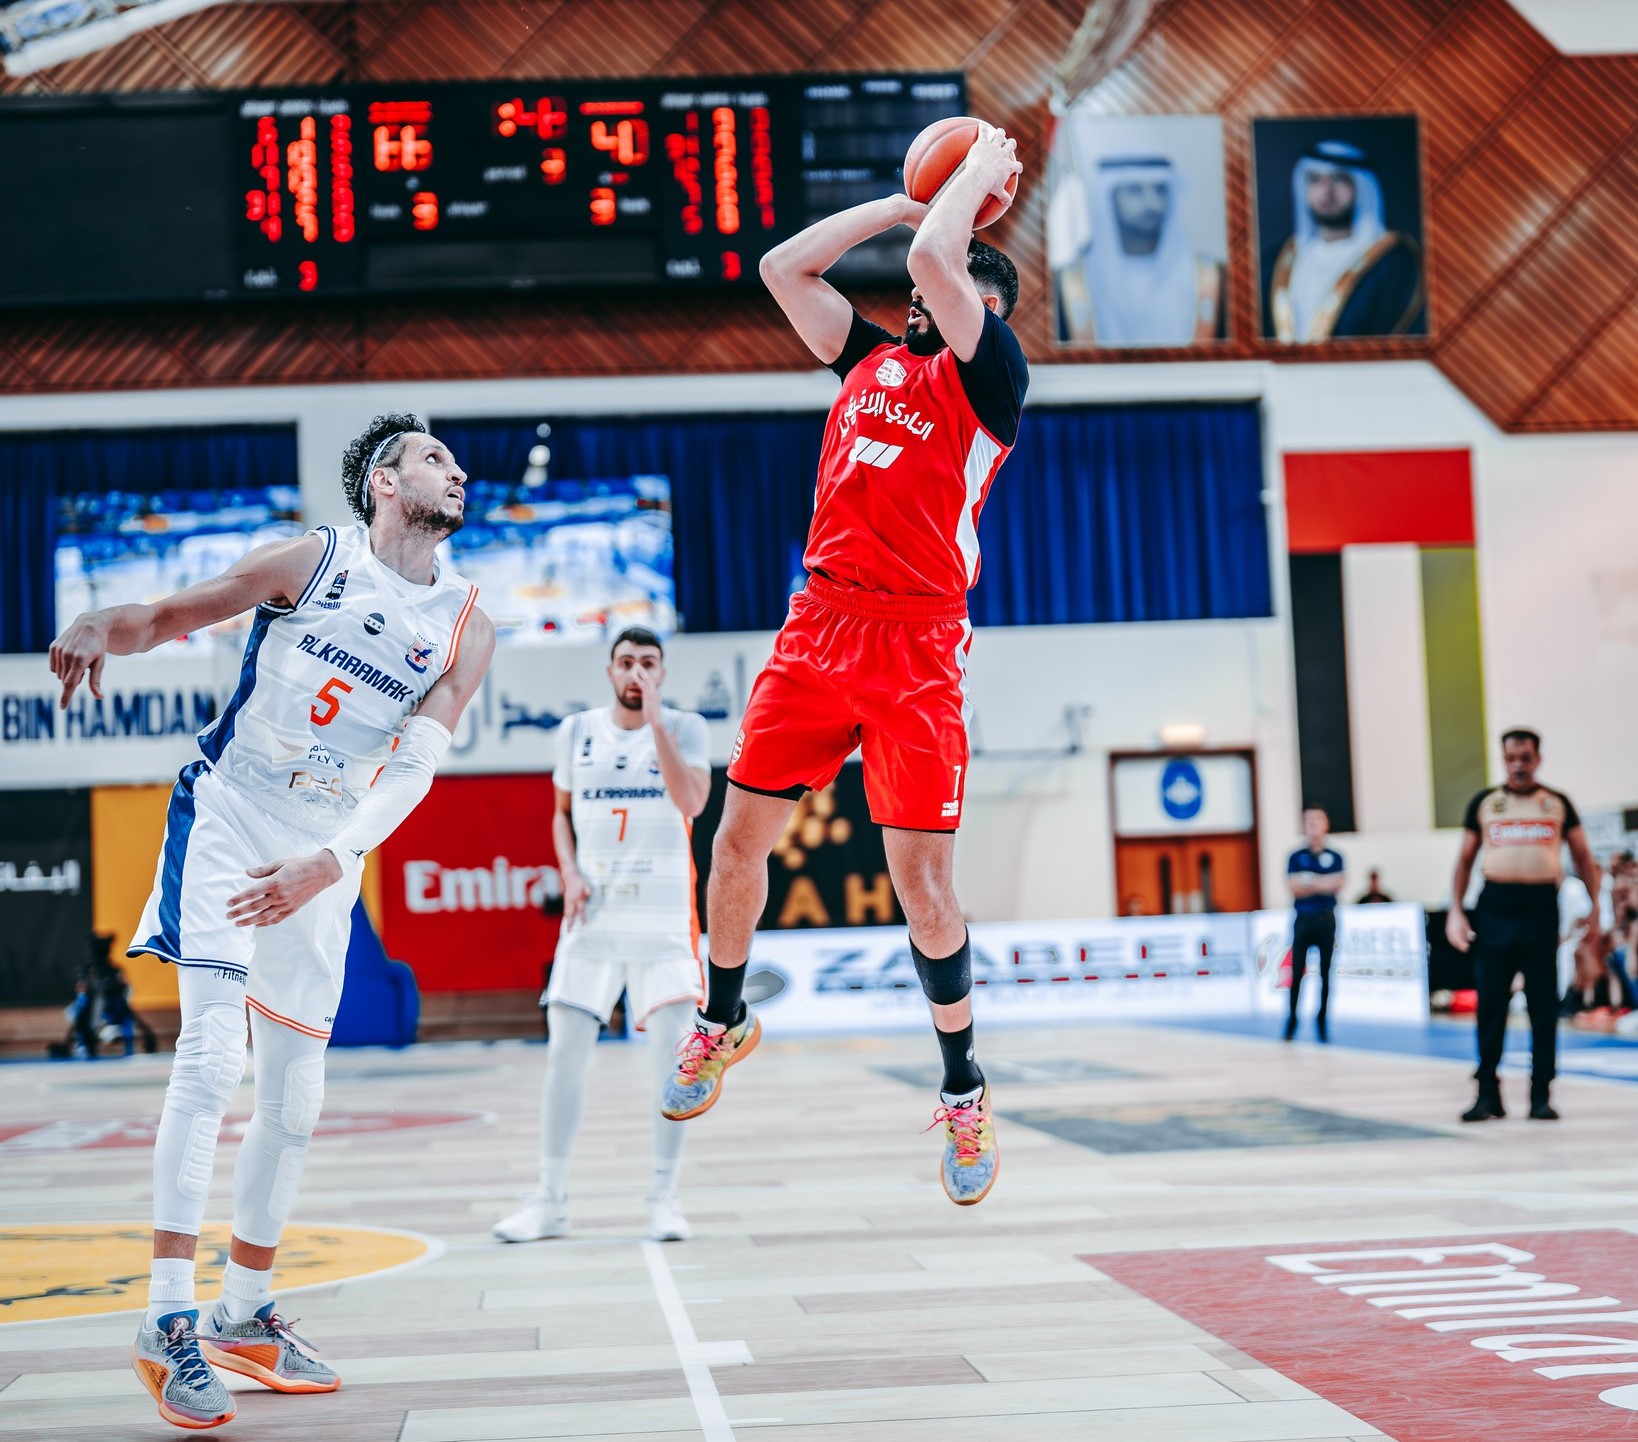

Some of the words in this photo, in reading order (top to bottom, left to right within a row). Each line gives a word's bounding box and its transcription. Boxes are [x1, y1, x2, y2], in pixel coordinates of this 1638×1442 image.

[3, 693, 55, 740] BIN
[310, 677, 354, 727] 5
[953, 765, 961, 798] 7
[612, 808, 628, 841] 7
[403, 856, 562, 914] Emira
